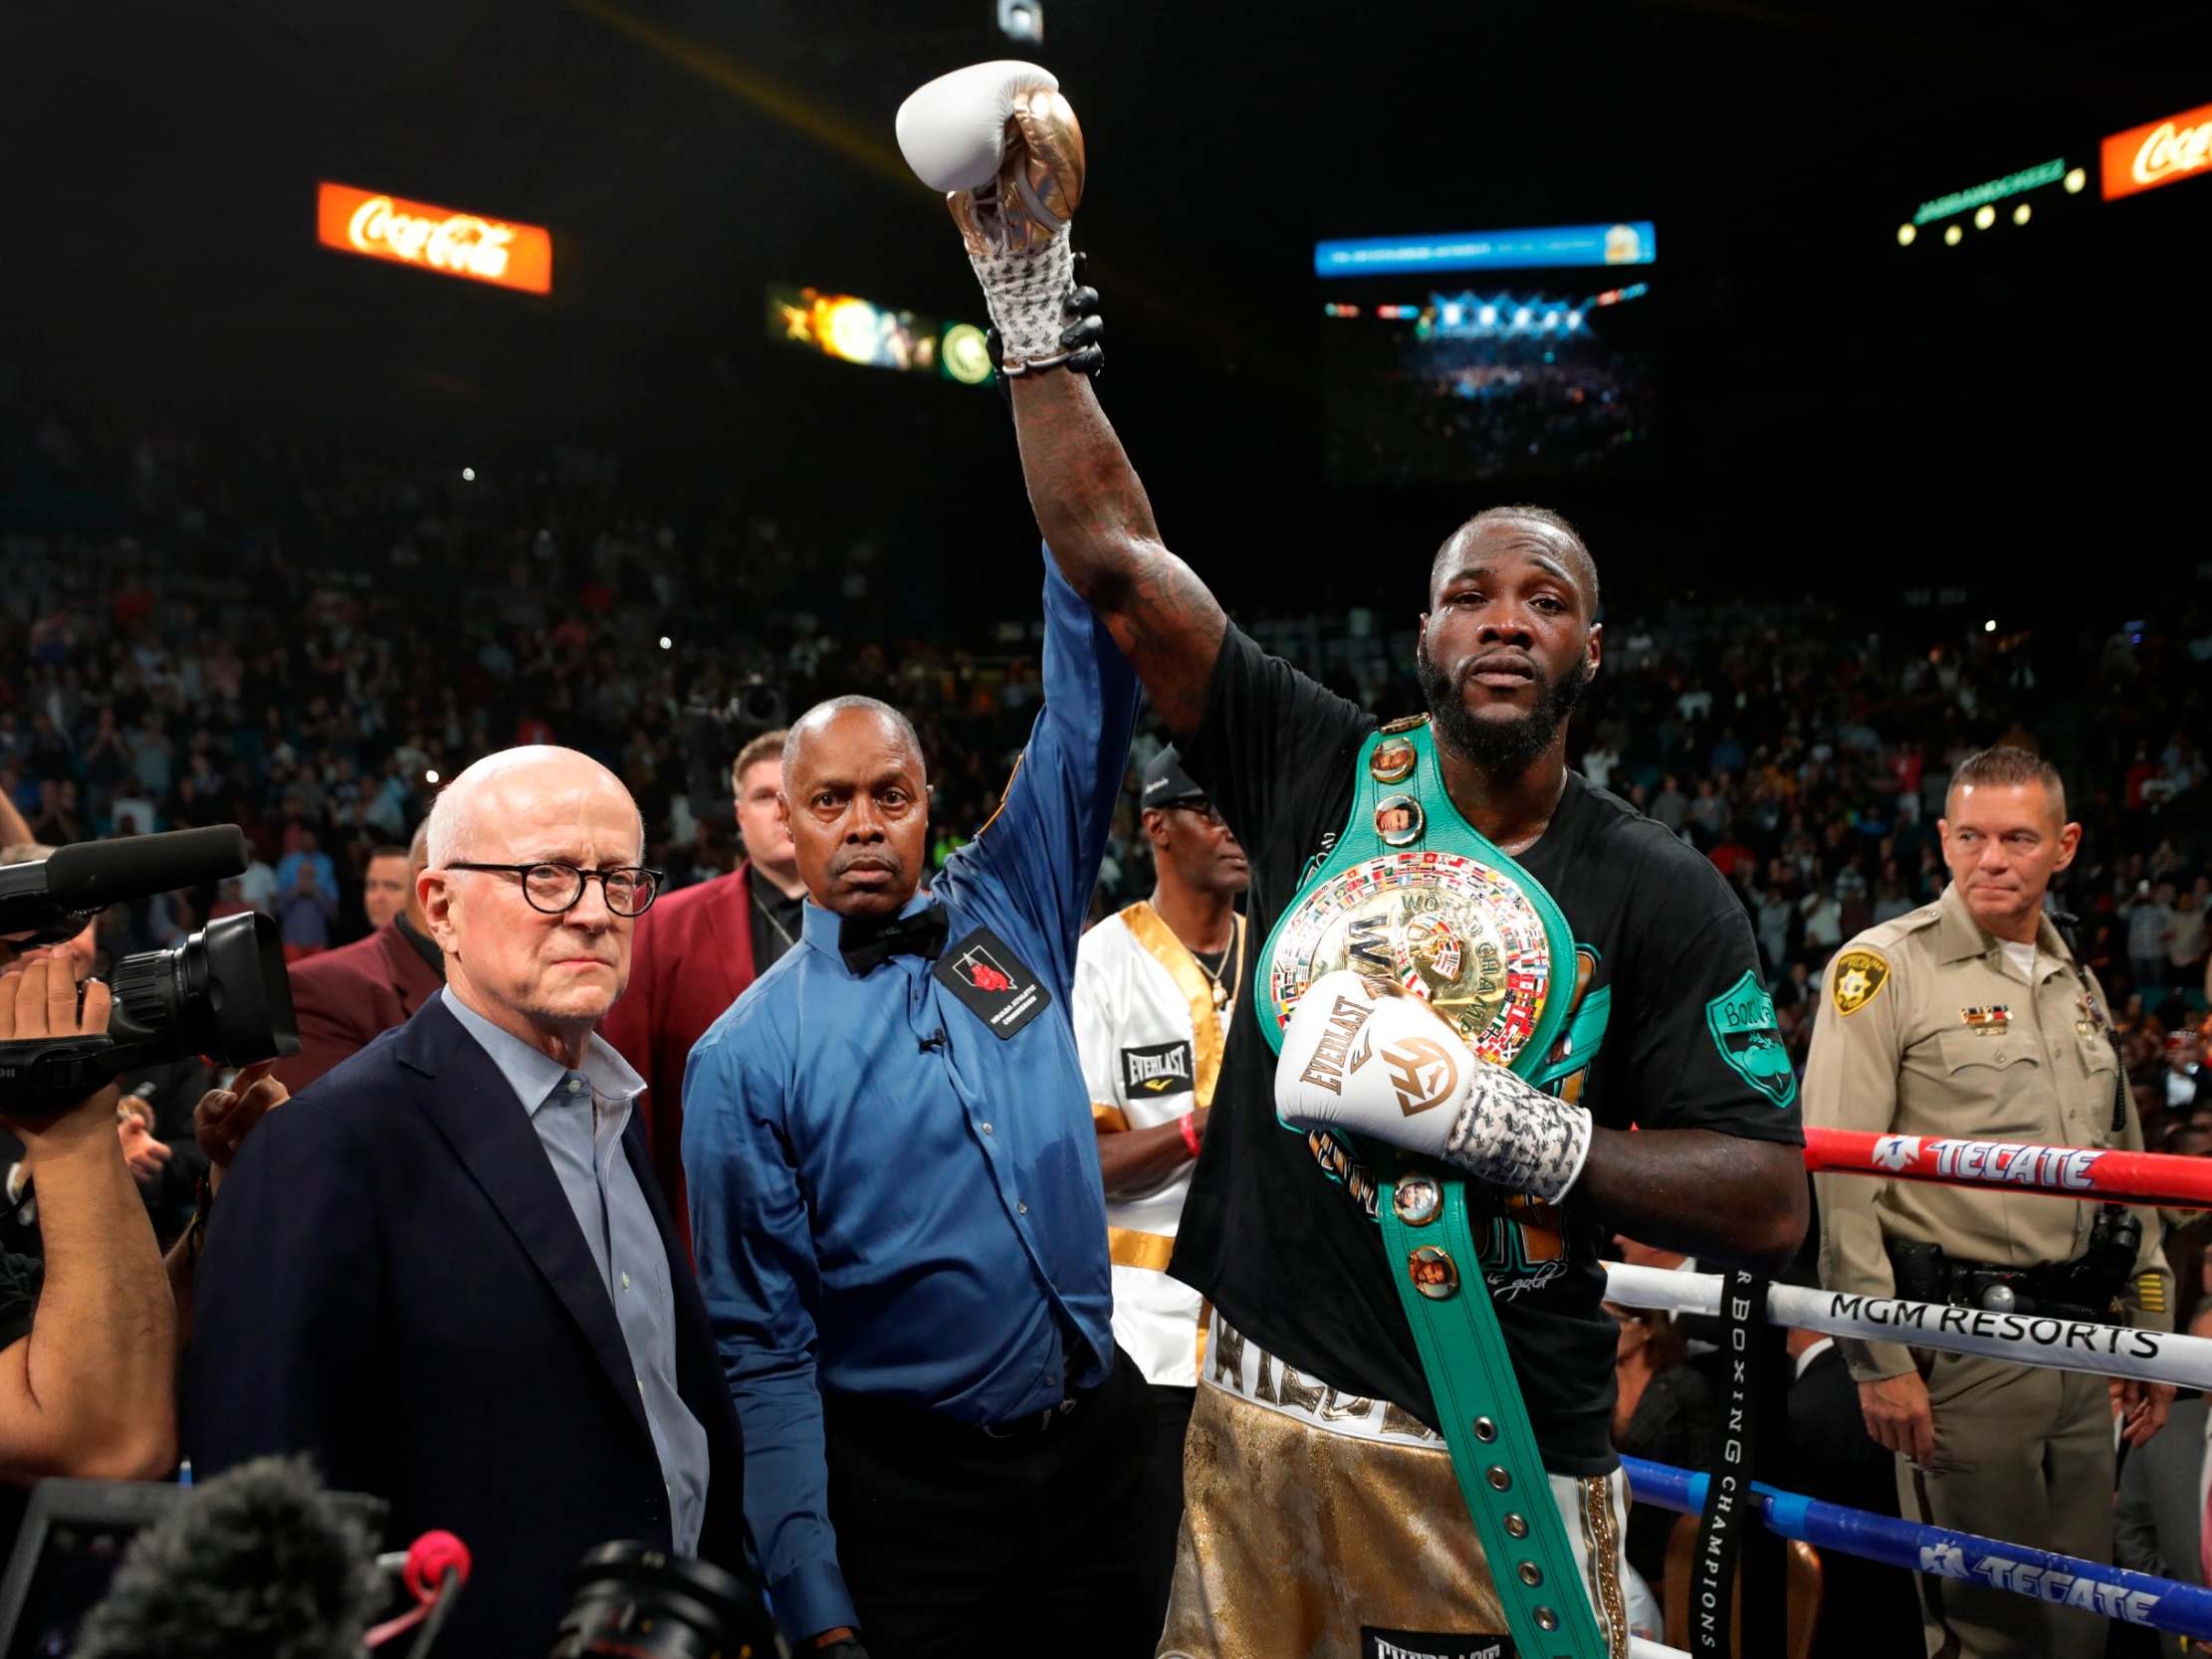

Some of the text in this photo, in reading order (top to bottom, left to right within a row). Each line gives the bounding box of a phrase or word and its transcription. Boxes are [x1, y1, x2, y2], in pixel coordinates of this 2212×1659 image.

[1127, 1045, 1189, 1086] EVERLAST
[1299, 995, 1375, 1096] EVERLAST
[1926, 1139, 2107, 1189] TECATE
[1830, 1293, 2164, 1359] MGM RESORTS
[1724, 1297, 1751, 1464] BOXING
[1700, 1476, 1736, 1648] CHAMPIONS
[1972, 1555, 2161, 1628] TECATE
